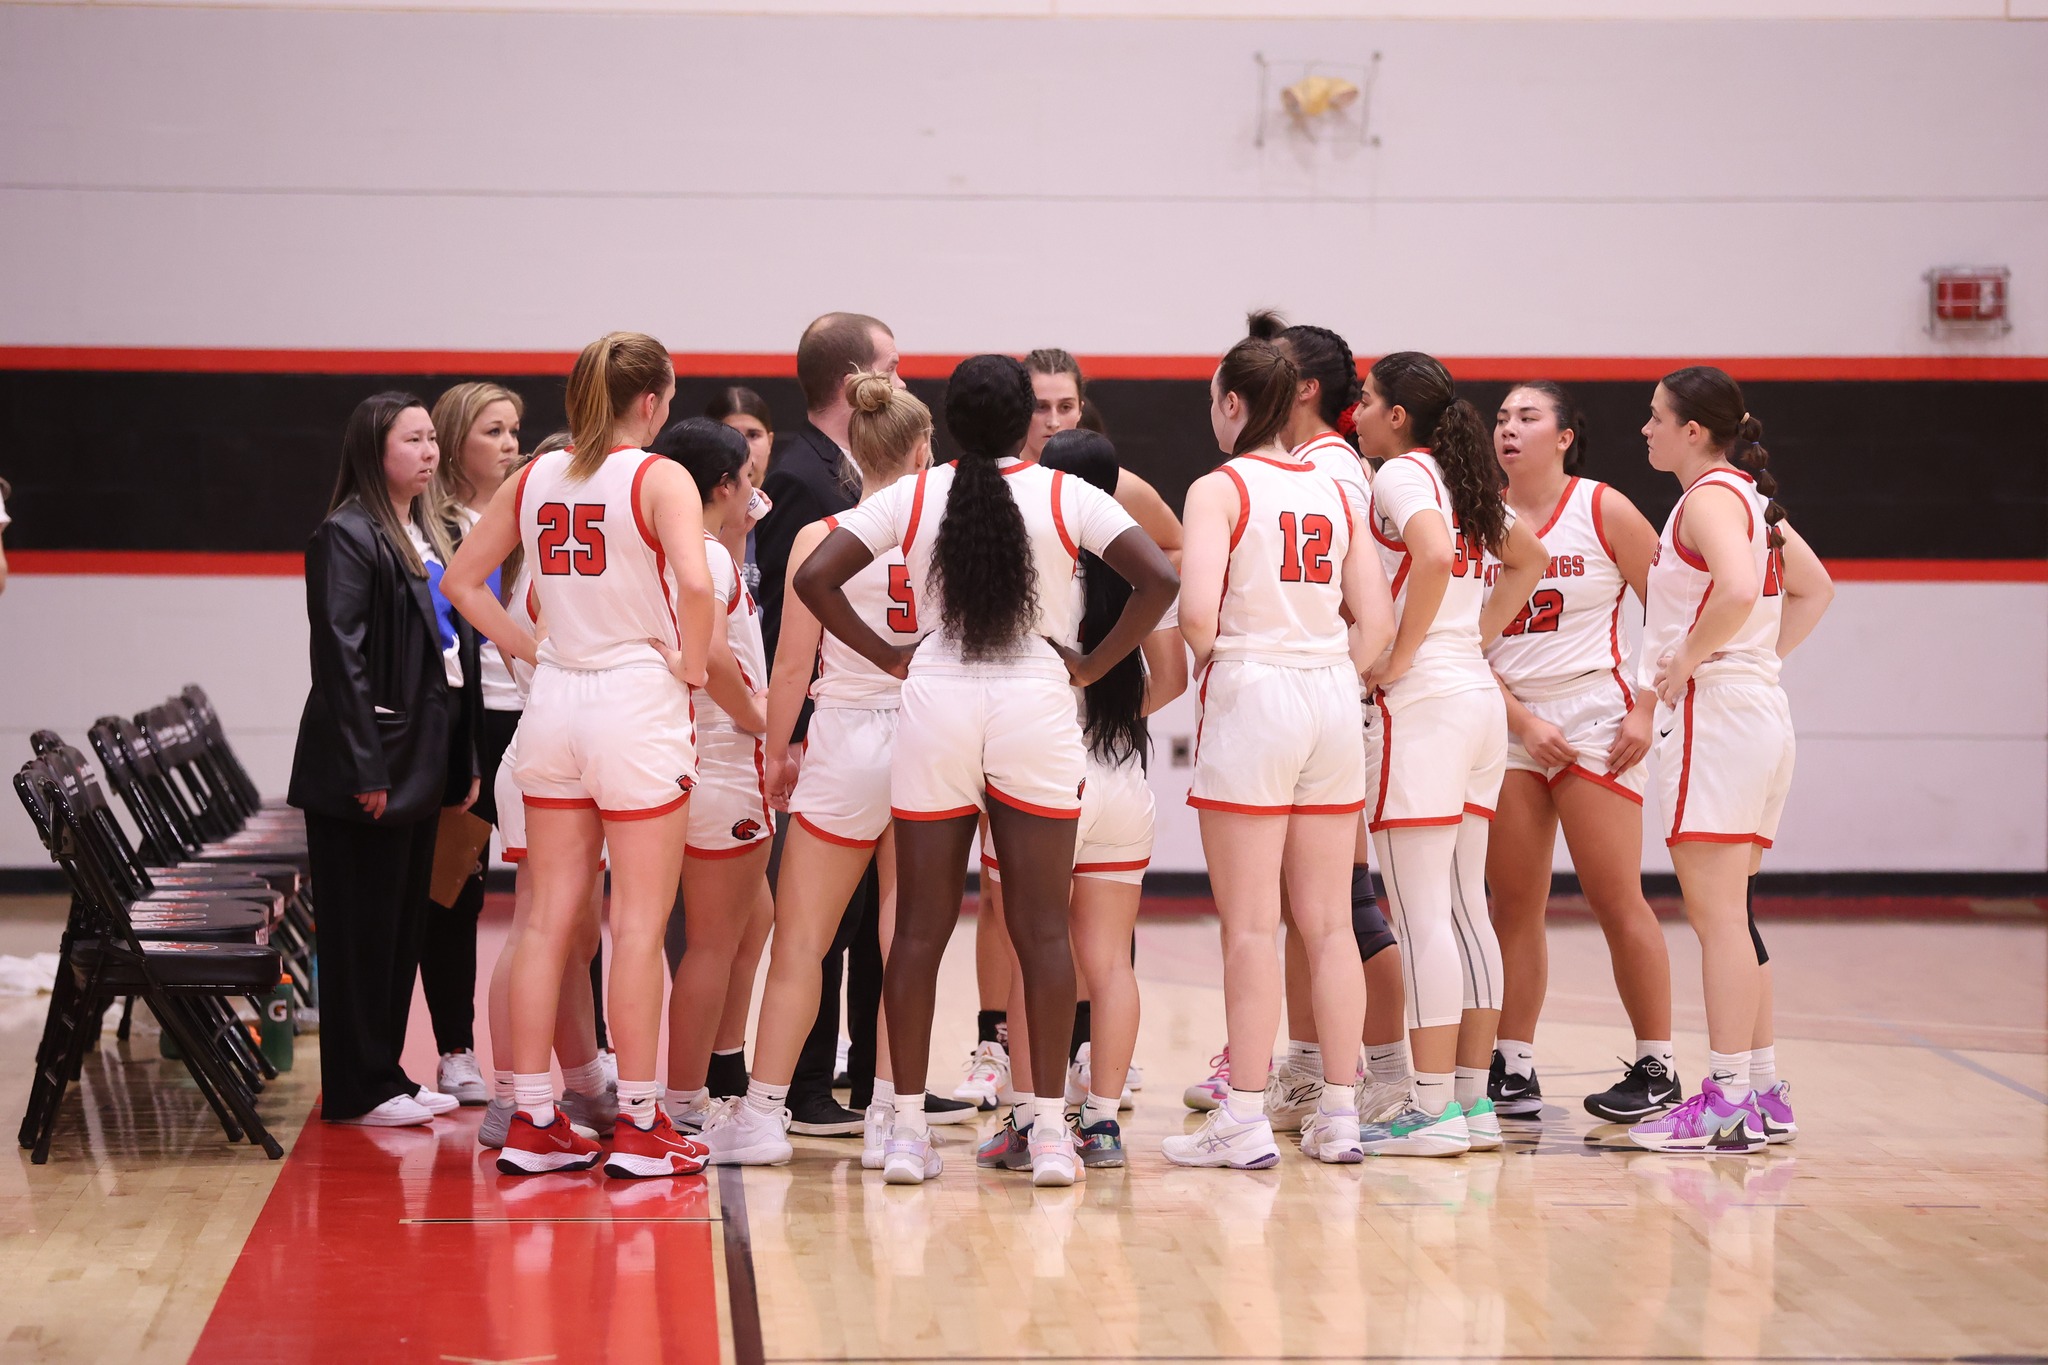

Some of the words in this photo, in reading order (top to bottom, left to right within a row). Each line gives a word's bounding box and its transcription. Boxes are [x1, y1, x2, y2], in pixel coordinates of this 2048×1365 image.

[537, 502, 606, 576] 25
[1279, 511, 1333, 584] 12
[887, 564, 918, 633] 5
[268, 1000, 288, 1022] G
